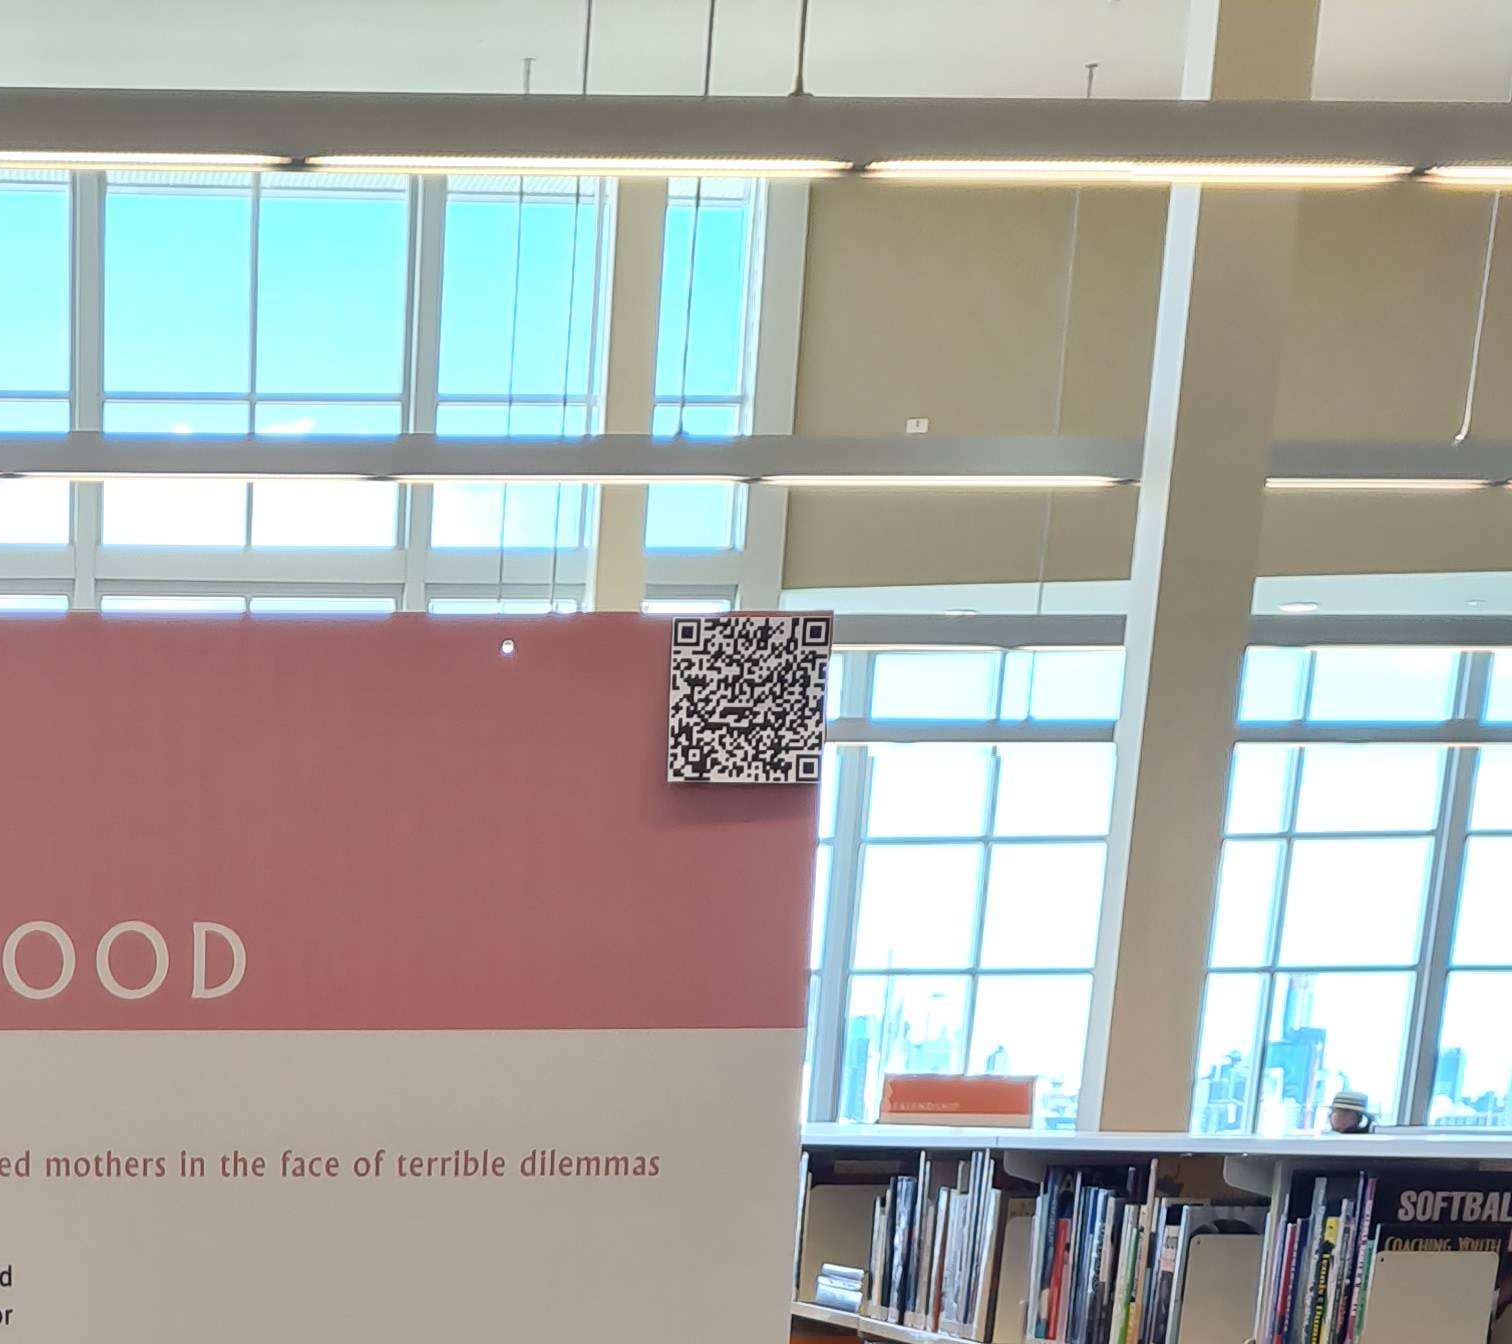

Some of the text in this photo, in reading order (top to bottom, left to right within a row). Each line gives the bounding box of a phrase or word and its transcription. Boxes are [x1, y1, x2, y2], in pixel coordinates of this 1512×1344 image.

[45, 1149, 166, 1178] mothers
[180, 1149, 205, 1178] in
[220, 1149, 266, 1178] the
[281, 1149, 340, 1178] face
[353, 1148, 387, 1178] of
[397, 1148, 506, 1178] terrible
[520, 1148, 660, 1177] dilemmas
